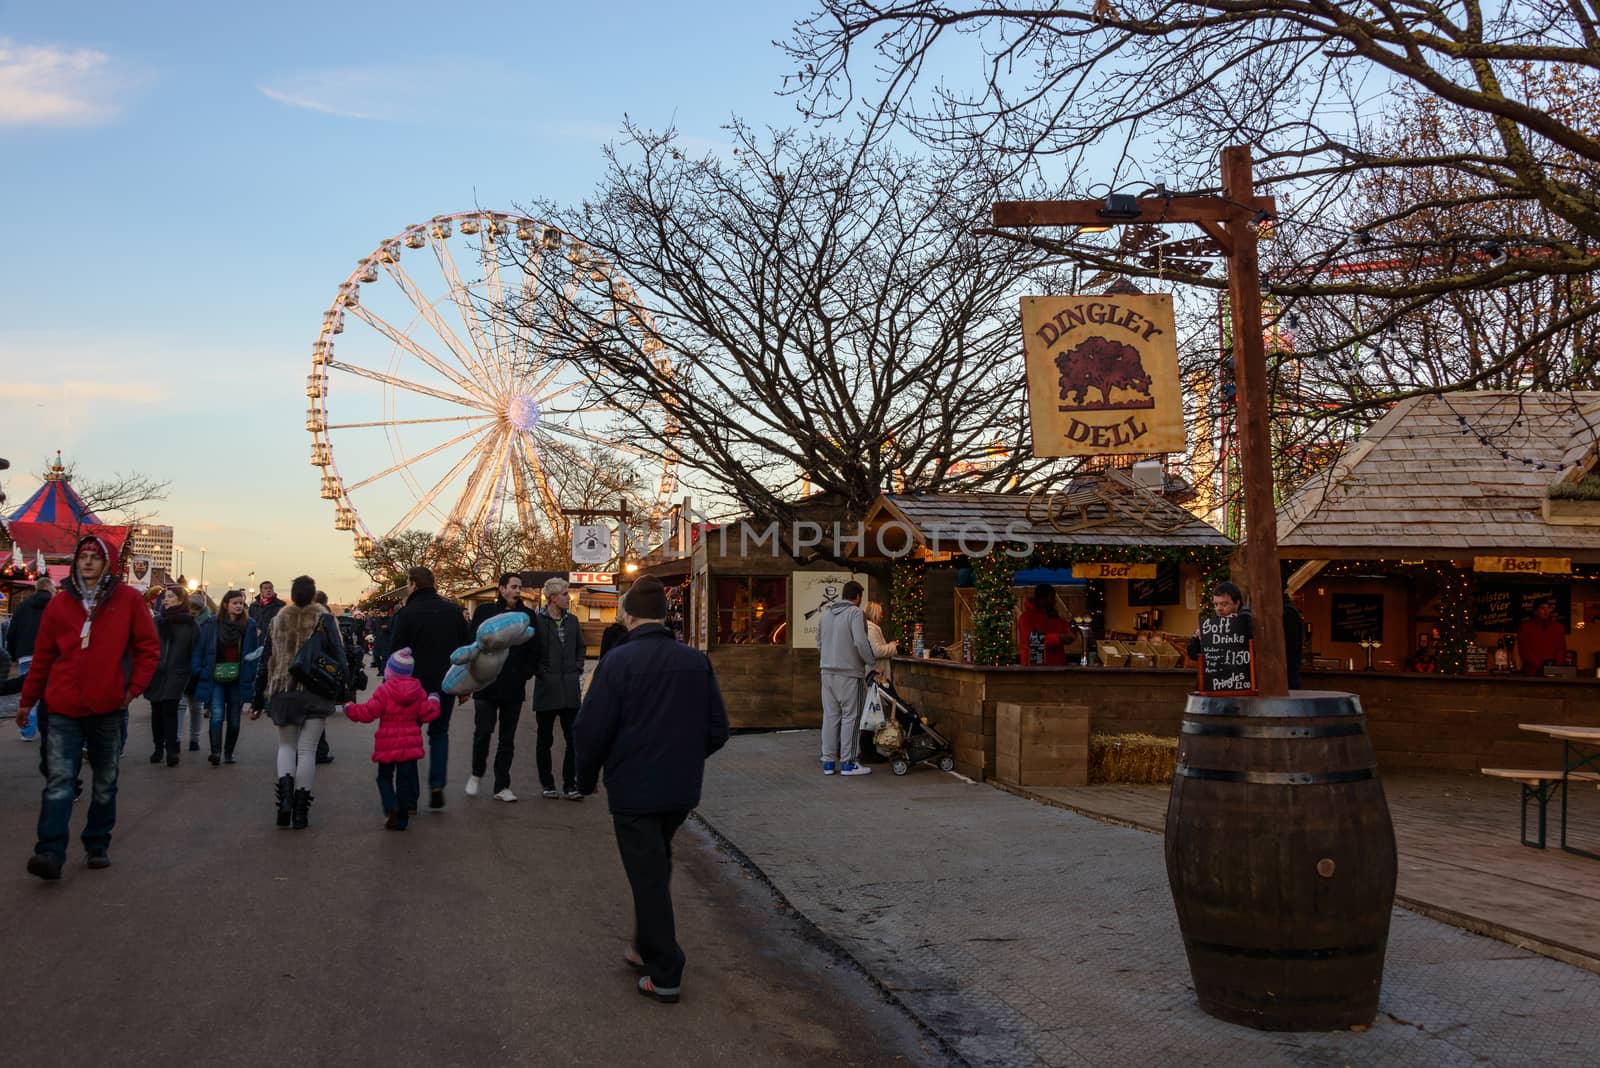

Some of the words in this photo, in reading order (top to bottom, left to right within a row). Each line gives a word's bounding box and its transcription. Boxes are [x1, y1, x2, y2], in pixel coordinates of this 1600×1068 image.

[1036, 303, 1163, 349] DINGLEY
[1064, 416, 1148, 447] DELL
[1100, 564, 1131, 576] Beer
[1503, 558, 1541, 571] Beer
[1202, 618, 1231, 634] Soft
[1212, 633, 1245, 644] Drinks
[1213, 672, 1246, 691] Pringles
